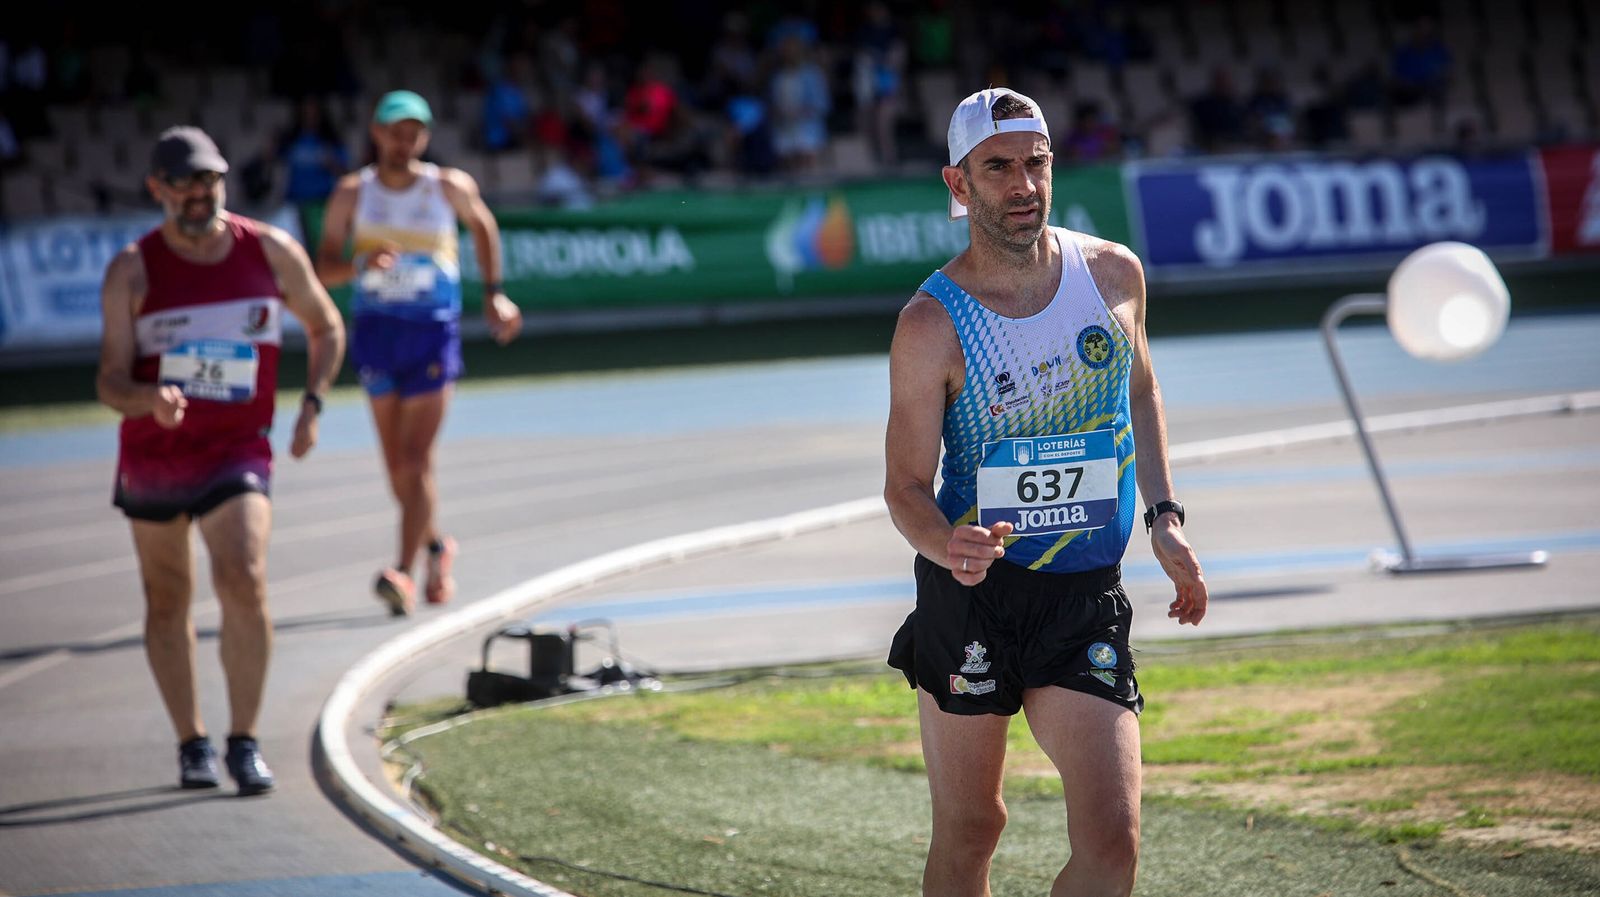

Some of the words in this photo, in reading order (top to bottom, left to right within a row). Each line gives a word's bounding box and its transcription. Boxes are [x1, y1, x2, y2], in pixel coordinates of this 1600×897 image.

[193, 361, 224, 380] 26
[1037, 438, 1086, 451] LOTERÍAS
[1016, 466, 1085, 503] 637
